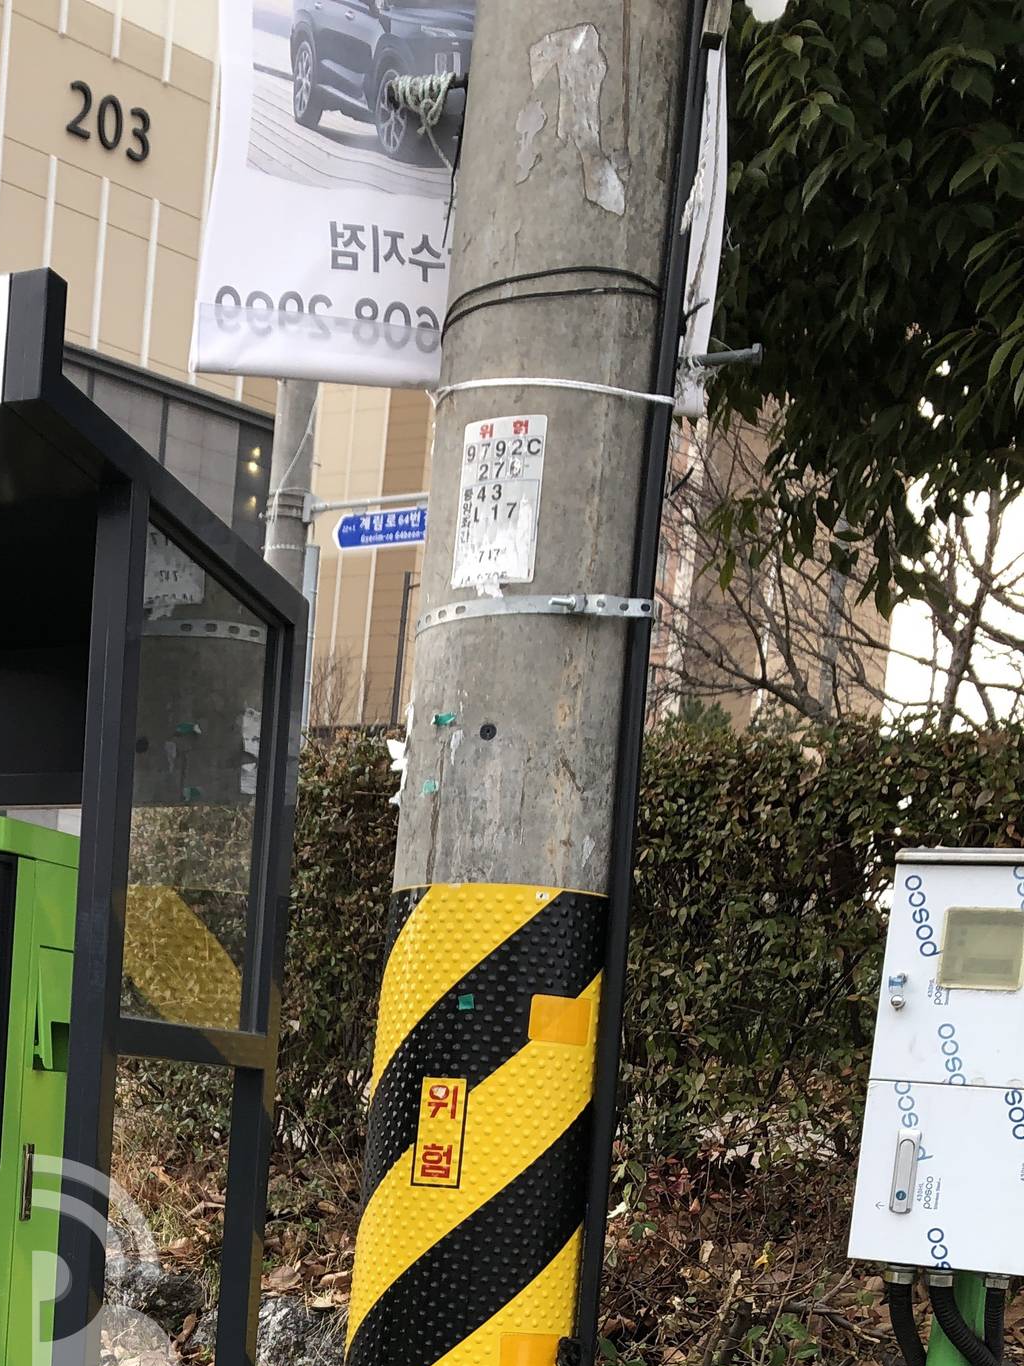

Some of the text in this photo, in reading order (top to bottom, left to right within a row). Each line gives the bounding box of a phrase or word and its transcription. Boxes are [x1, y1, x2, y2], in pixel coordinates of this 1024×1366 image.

[66, 80, 150, 161] 203
[467, 438, 541, 462] 9792C
[360, 511, 429, 531] 계림로64번
[905, 875, 942, 957] posco
[923, 1176, 934, 1209] posco
